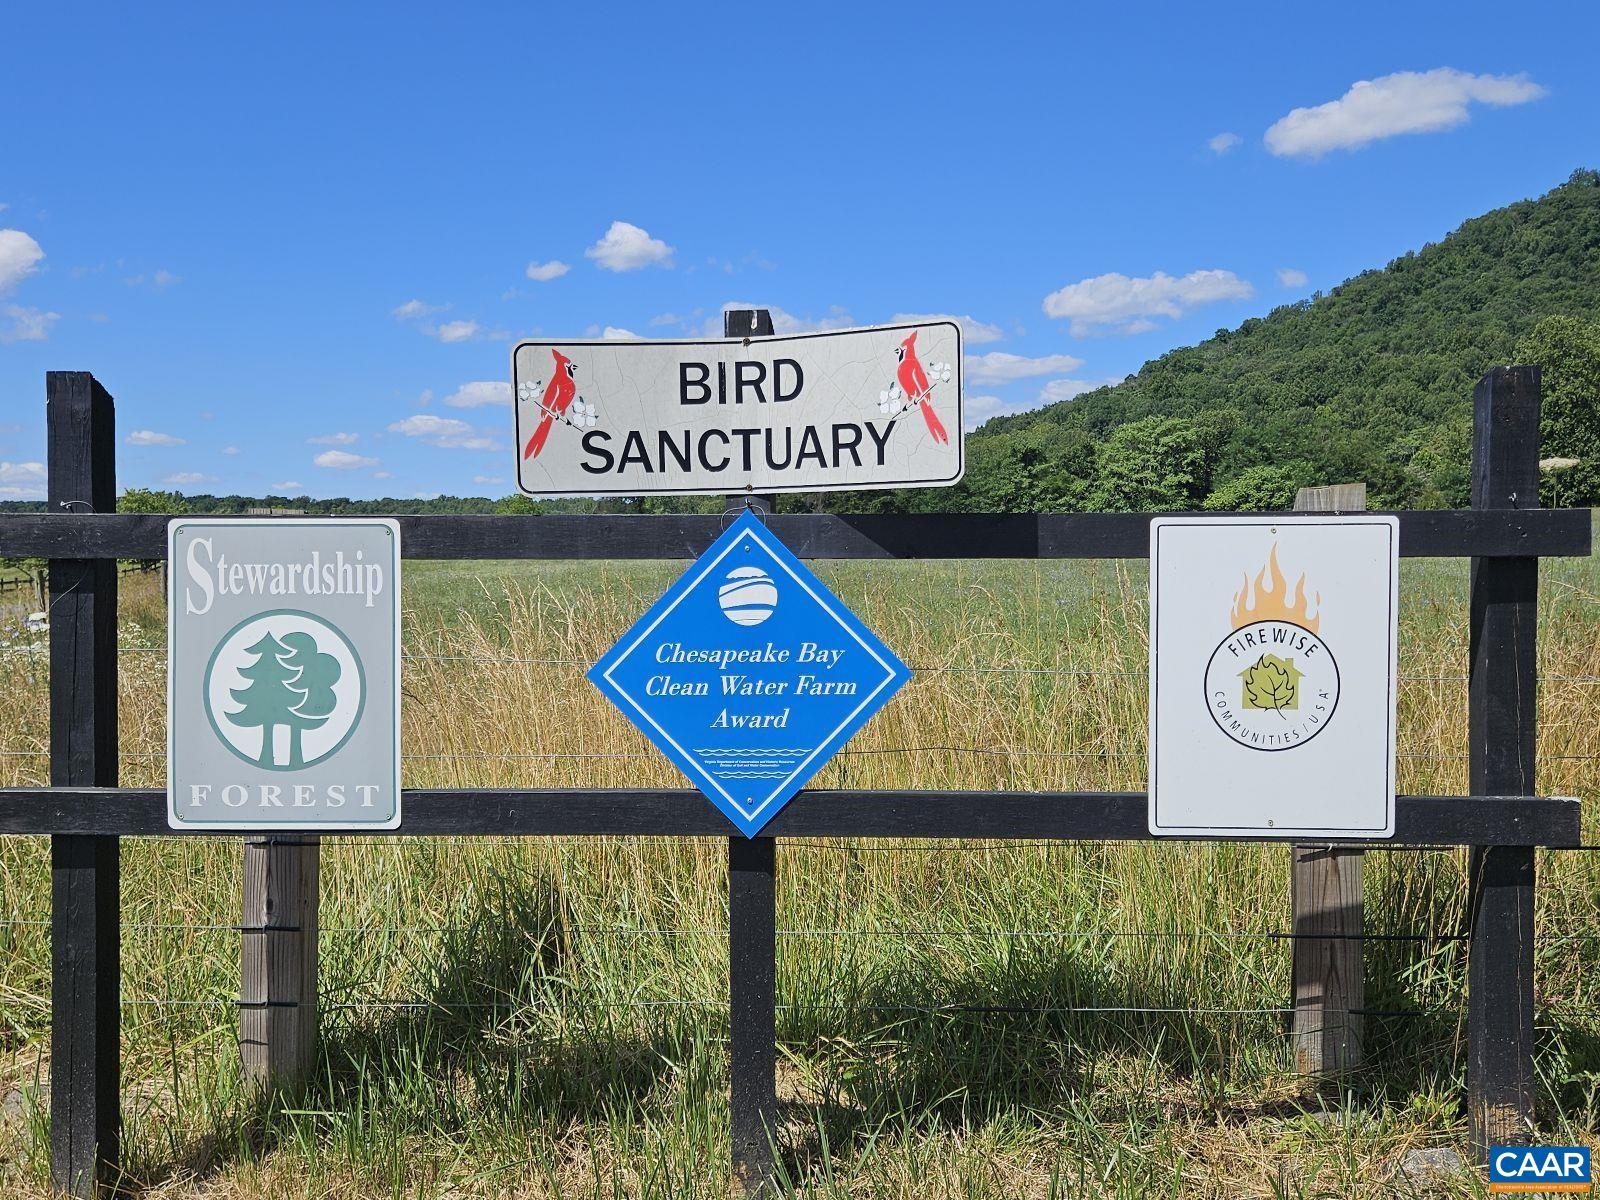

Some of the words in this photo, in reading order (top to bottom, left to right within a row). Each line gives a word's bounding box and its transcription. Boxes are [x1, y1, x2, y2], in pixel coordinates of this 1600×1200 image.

[679, 359, 804, 405] BIRD
[580, 421, 896, 474] SANCTUARY
[186, 537, 383, 615] Stewardship
[655, 643, 789, 669] Chesapeake
[796, 643, 845, 669] Bay
[1228, 628, 1319, 657] FIREWISE
[645, 676, 709, 696] Clean
[721, 676, 788, 695] Water
[794, 676, 857, 695] Farm
[710, 708, 790, 728] Award
[189, 784, 379, 807] FOREST
